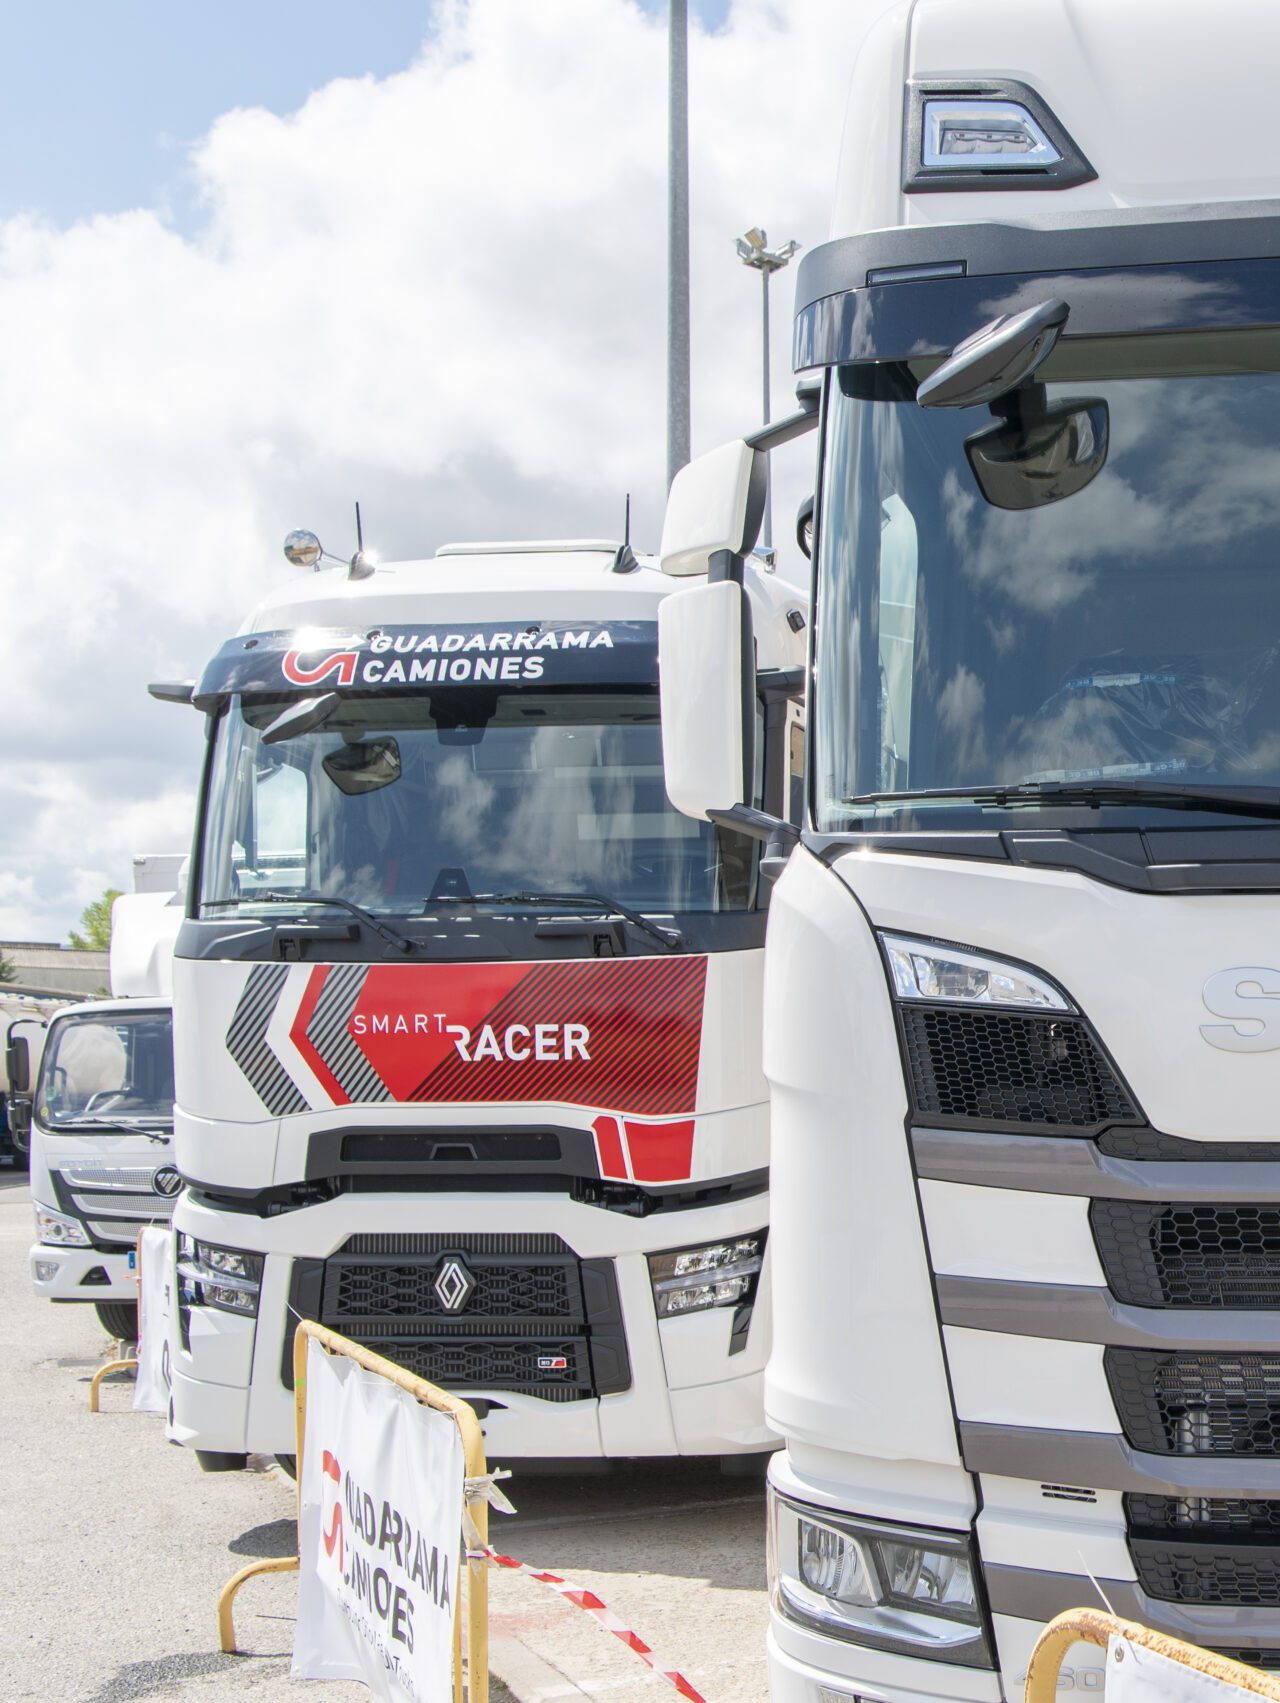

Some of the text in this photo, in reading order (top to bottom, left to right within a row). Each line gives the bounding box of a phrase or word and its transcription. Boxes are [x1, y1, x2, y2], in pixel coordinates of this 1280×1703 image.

[369, 630, 615, 654] GUADARRAMA
[362, 656, 545, 684] CAMIONES
[353, 1013, 447, 1035] SMART
[445, 1023, 592, 1062] RACER
